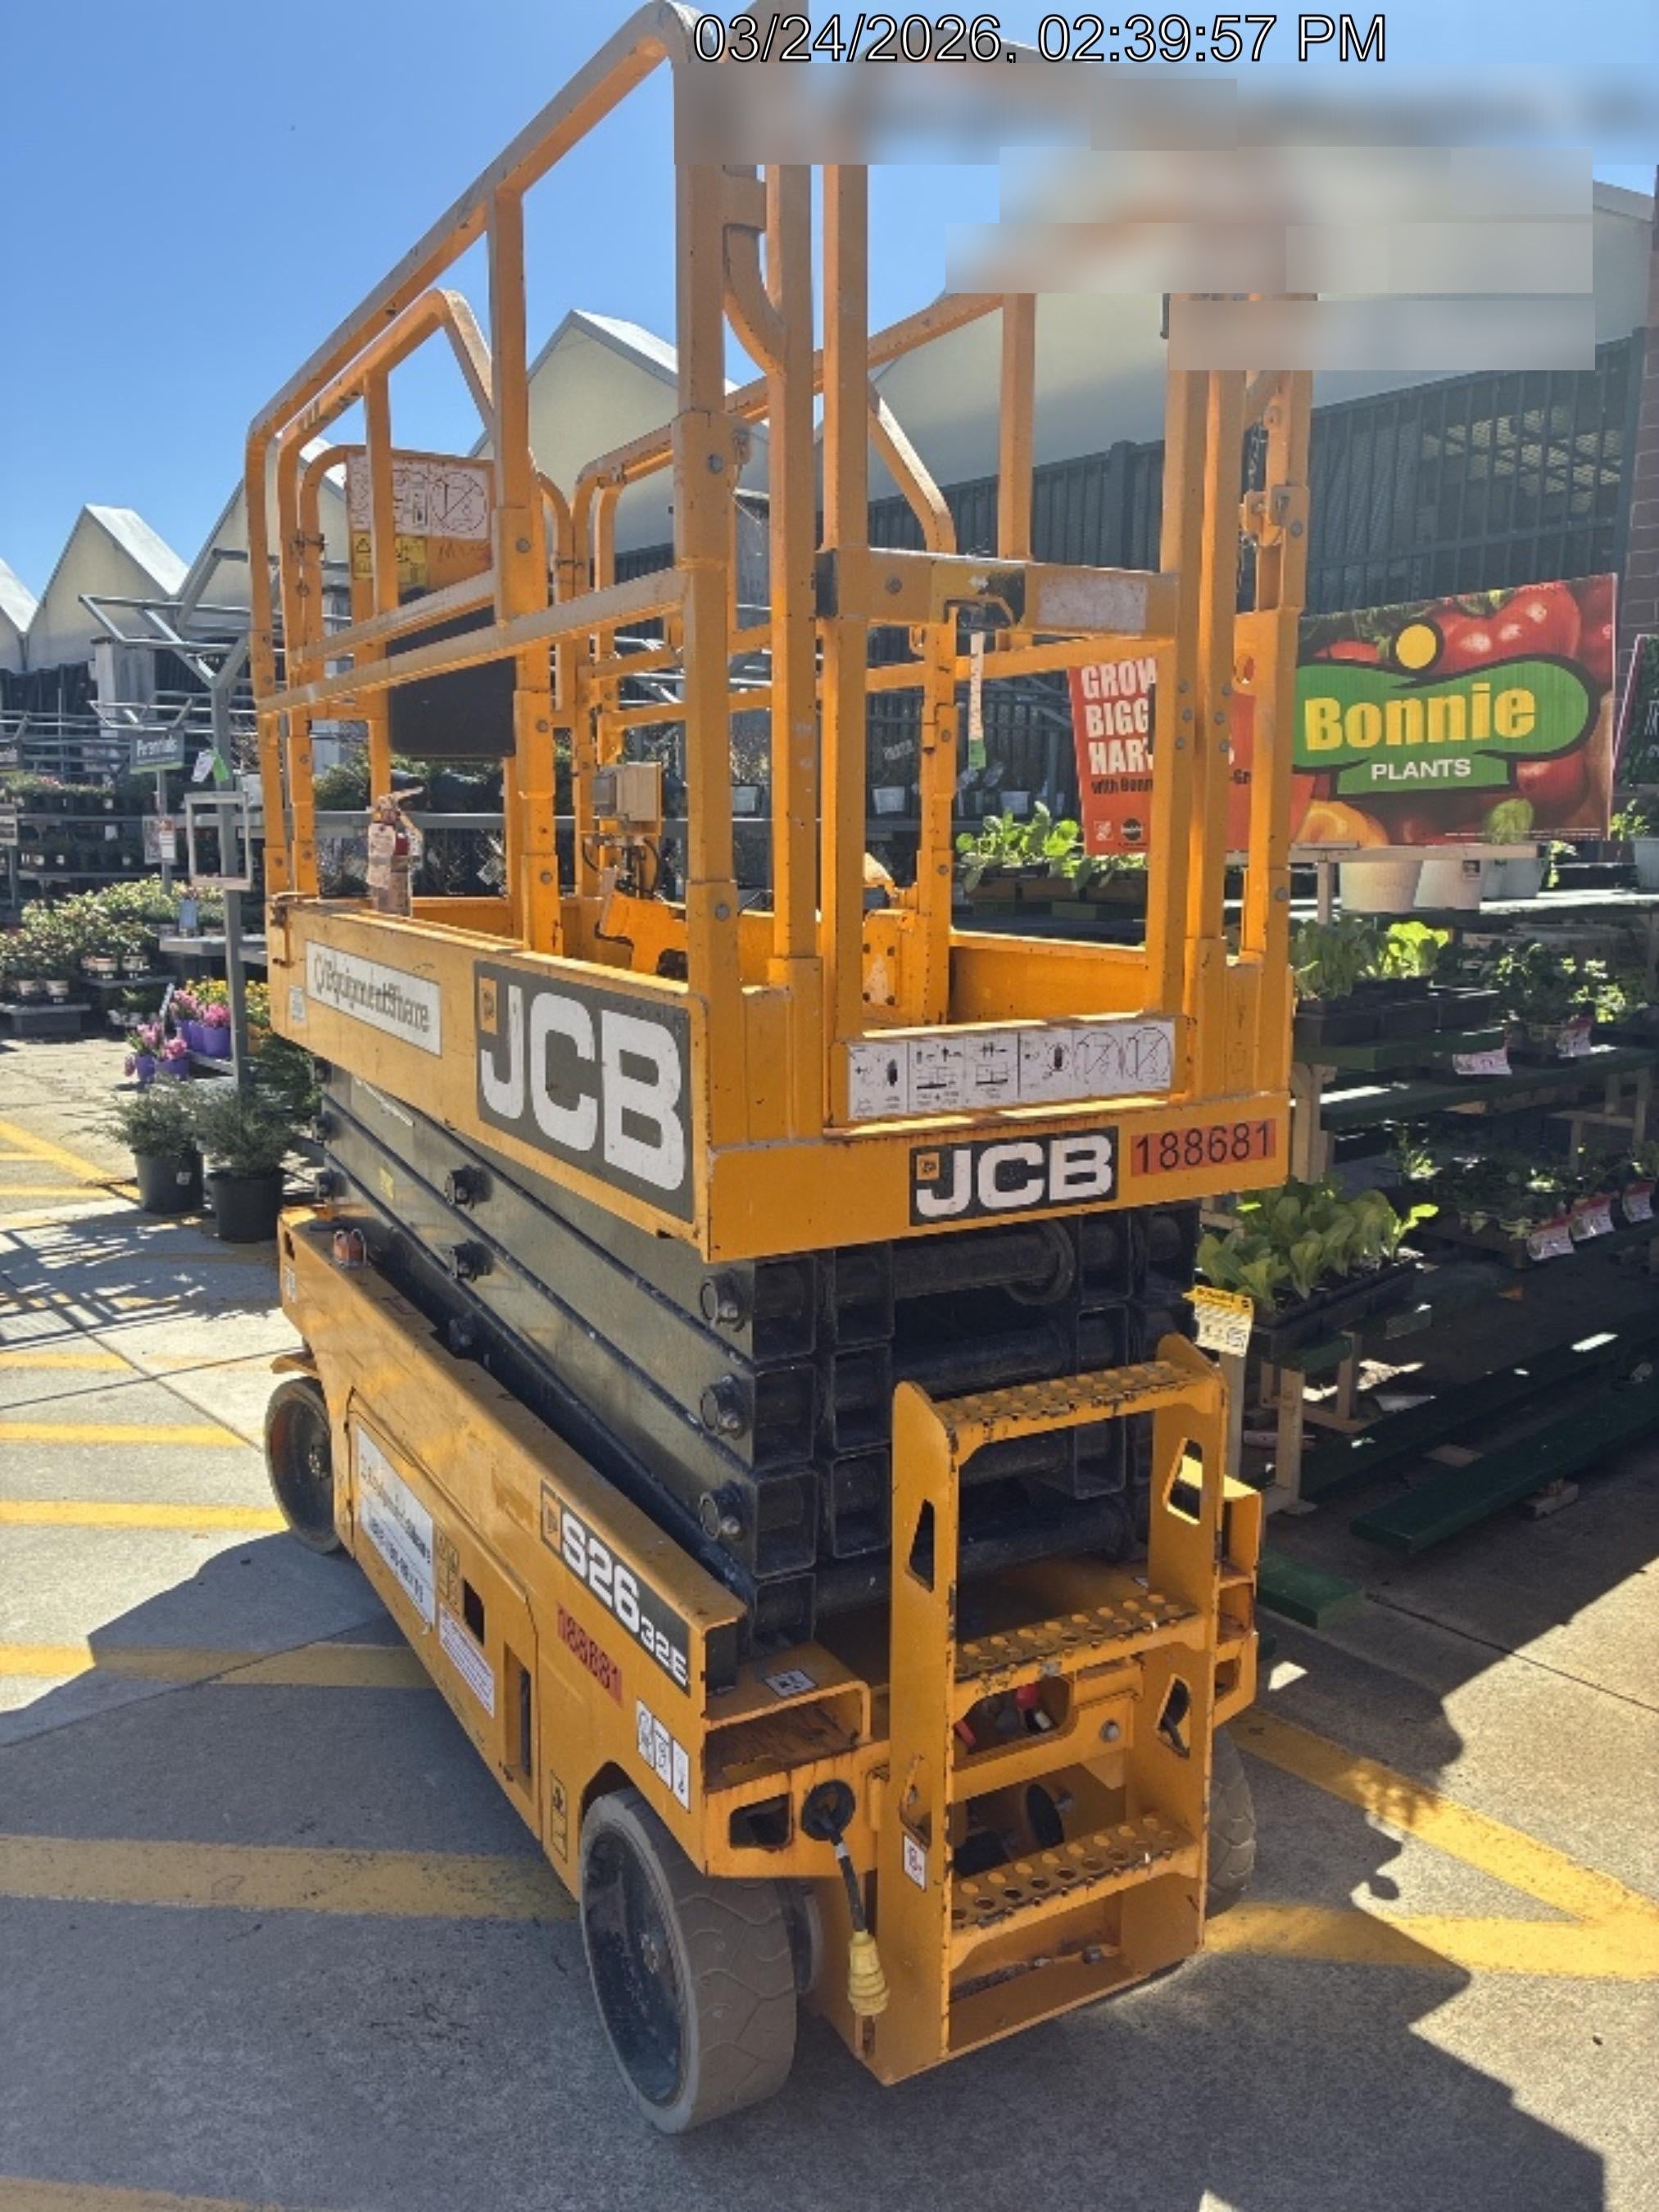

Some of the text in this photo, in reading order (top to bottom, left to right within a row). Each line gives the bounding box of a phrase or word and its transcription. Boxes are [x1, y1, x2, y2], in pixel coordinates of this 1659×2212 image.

[1085, 697, 1148, 737] BIGG
[1304, 682, 1536, 751] Bonnie
[1119, 777, 1153, 793] Bonn
[1371, 759, 1472, 781] PLANTS
[480, 984, 685, 1191] JCB
[915, 1120, 1271, 1218] JCB 188681
